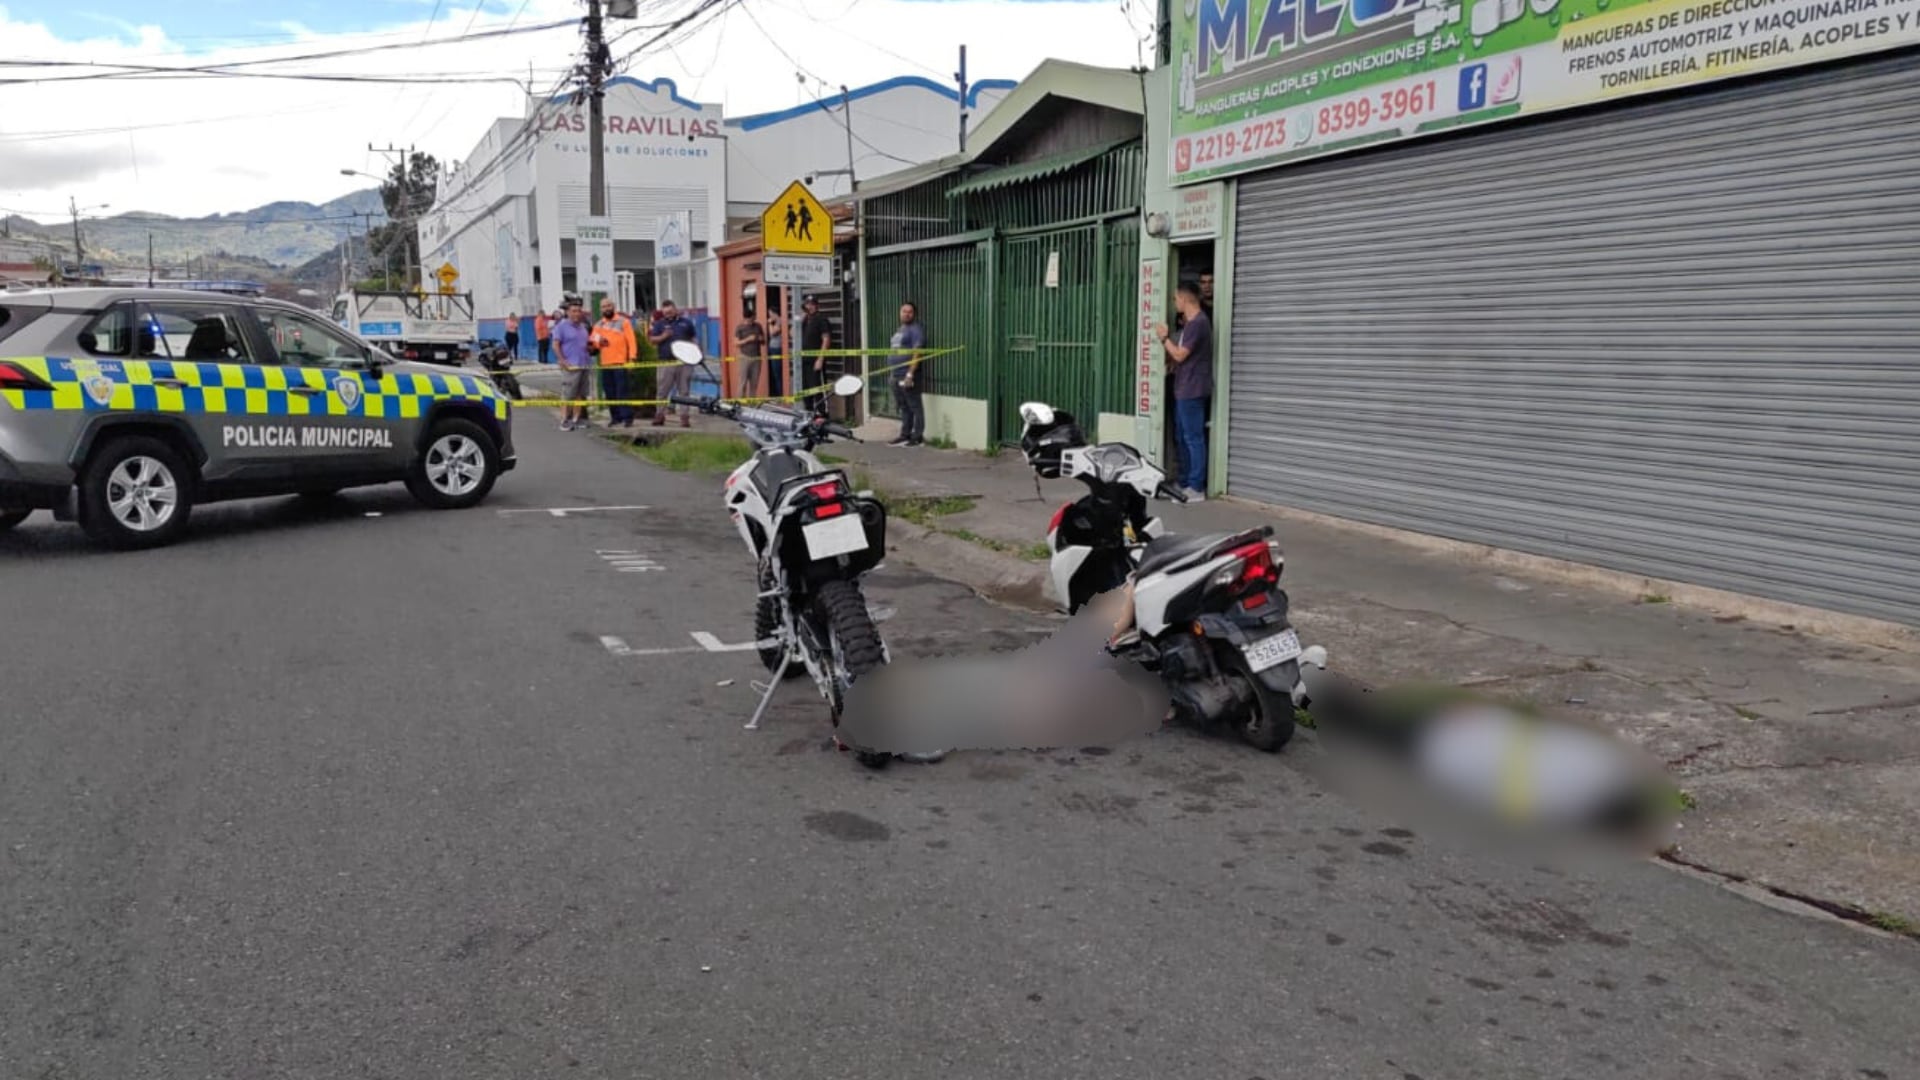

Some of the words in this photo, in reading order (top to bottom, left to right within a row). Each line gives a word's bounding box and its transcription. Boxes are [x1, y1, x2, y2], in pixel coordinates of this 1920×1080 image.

[1562, 20, 1654, 53] MANGUERAS
[1658, 12, 1680, 31] DE
[1568, 52, 1626, 74] FRENOS
[1629, 24, 1734, 60] AUTOMOTRIZ
[1738, 20, 1750, 37] Y
[1754, 0, 1878, 33] MAQUINARIA
[1800, 16, 1890, 50] ACOPLES
[1896, 11, 1910, 31] Y
[1194, 87, 1261, 117] MANGUERAS
[1263, 70, 1318, 99] ACOPLES
[1321, 69, 1332, 84] Y
[1333, 43, 1426, 79] CONEXIONES
[1431, 33, 1461, 51] S.A.
[538, 114, 586, 133] LAS
[602, 115, 719, 137] RAVILIAS
[1317, 79, 1437, 137] 8399-3961
[1194, 117, 1287, 165] 2219-2723
[1139, 265, 1153, 413] MANGUERAS
[223, 425, 297, 447] POLICIA
[301, 426, 393, 448] MUNICIPAL
